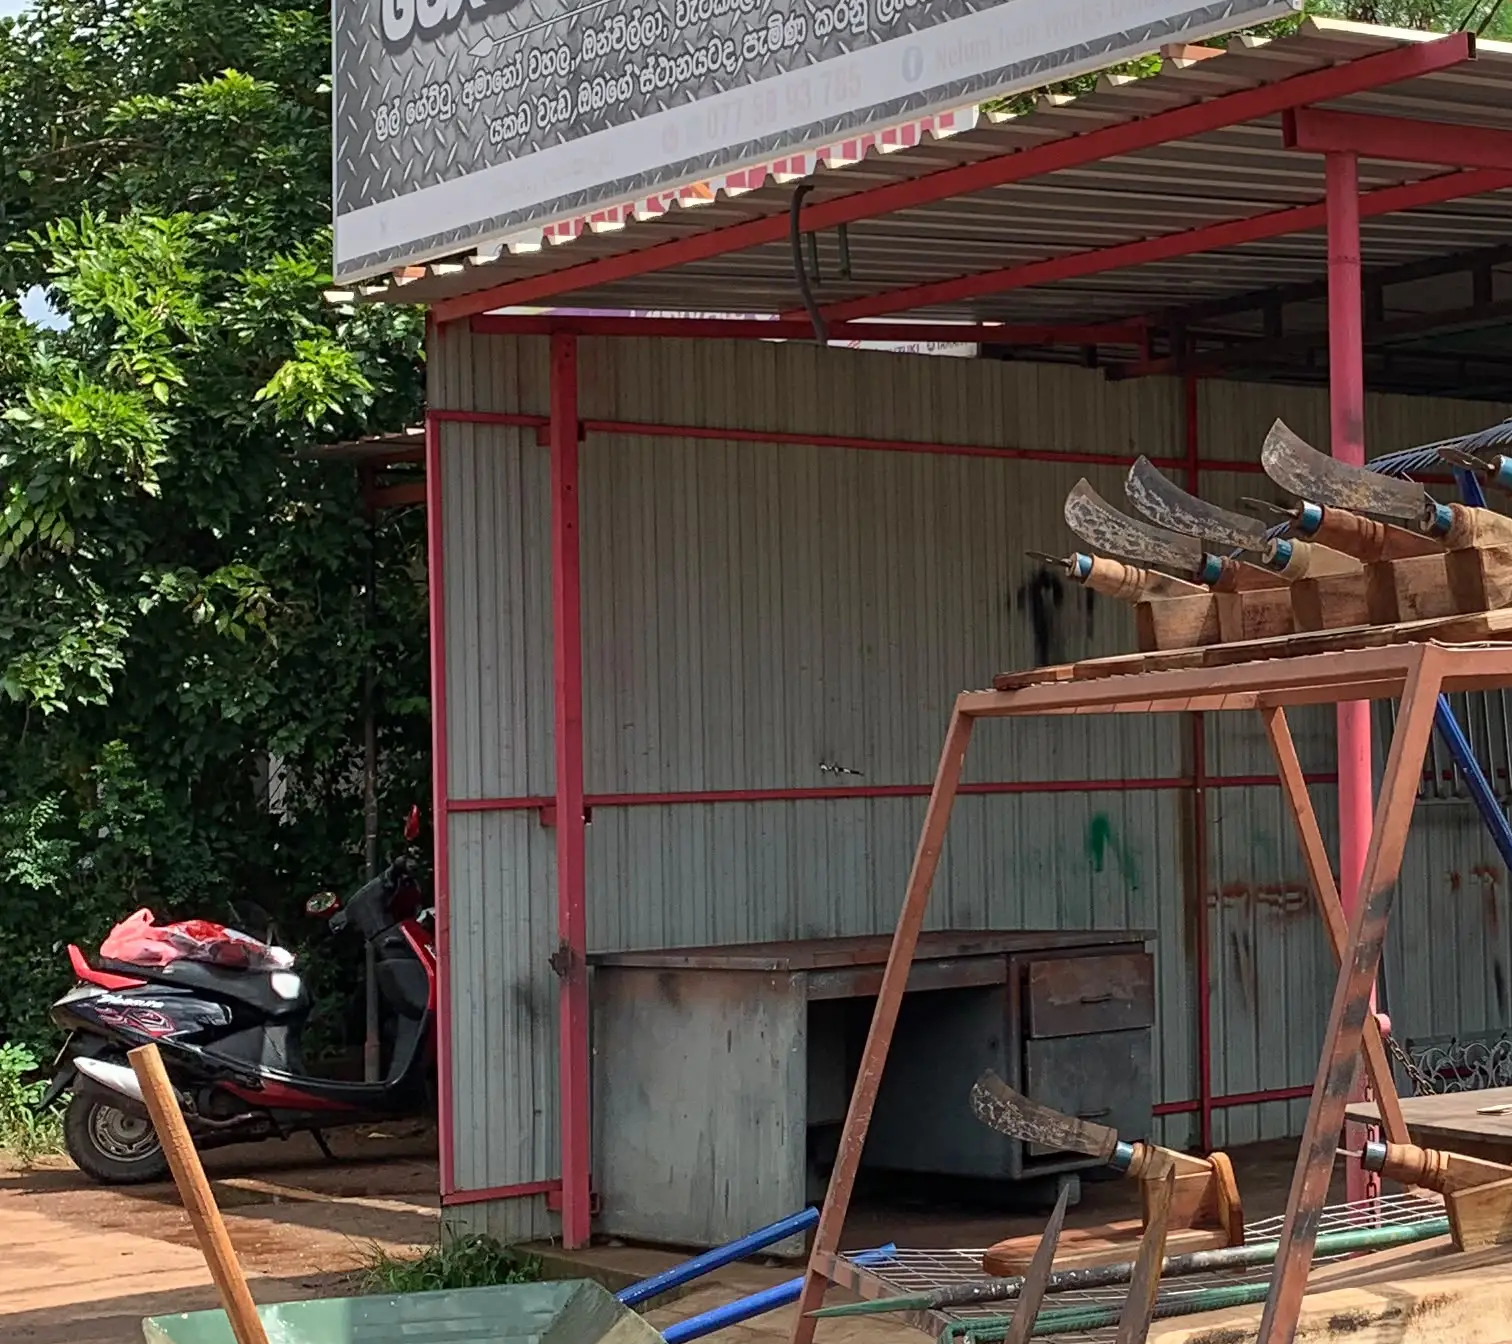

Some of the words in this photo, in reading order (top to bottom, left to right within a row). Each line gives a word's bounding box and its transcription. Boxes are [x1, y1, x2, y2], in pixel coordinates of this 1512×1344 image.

[489, 108, 531, 145] යකඩ
[577, 67, 633, 115] ඔබගේ
[706, 97, 744, 140] 077
